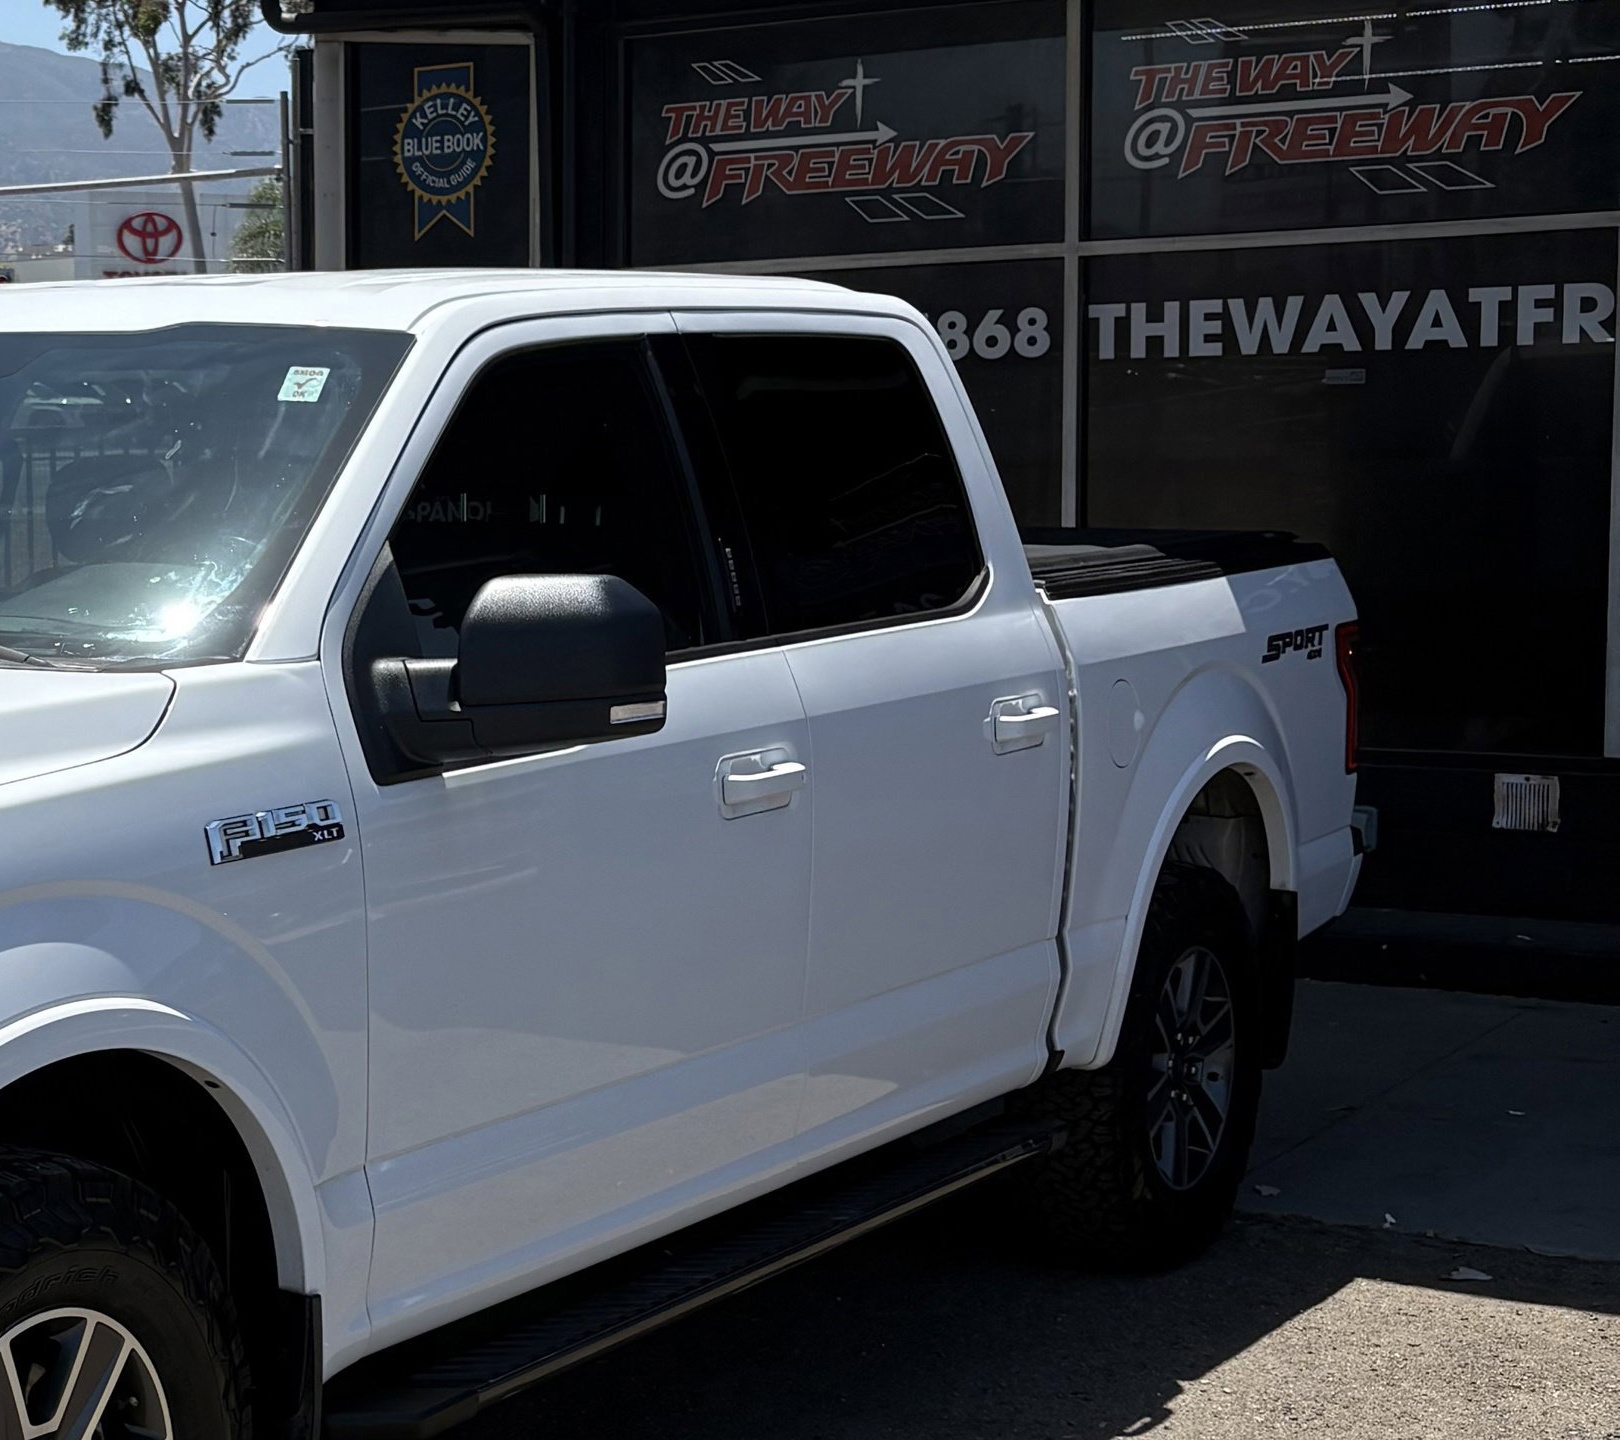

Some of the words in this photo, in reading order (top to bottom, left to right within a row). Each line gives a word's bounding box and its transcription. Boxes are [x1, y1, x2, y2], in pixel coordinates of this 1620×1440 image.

[1129, 59, 1232, 111] THE
[1235, 48, 1362, 96] WAY
[412, 98, 479, 130] KELLEY
[661, 98, 748, 146] THE
[750, 88, 854, 132] WAY
[404, 136, 442, 157] BLUE
[443, 132, 484, 153] BOOK
[412, 162, 450, 188] OFFICIAL
[451, 158, 477, 185] GUIDE
[1261, 623, 1329, 664] SPORT
[312, 827, 340, 841] XLT
